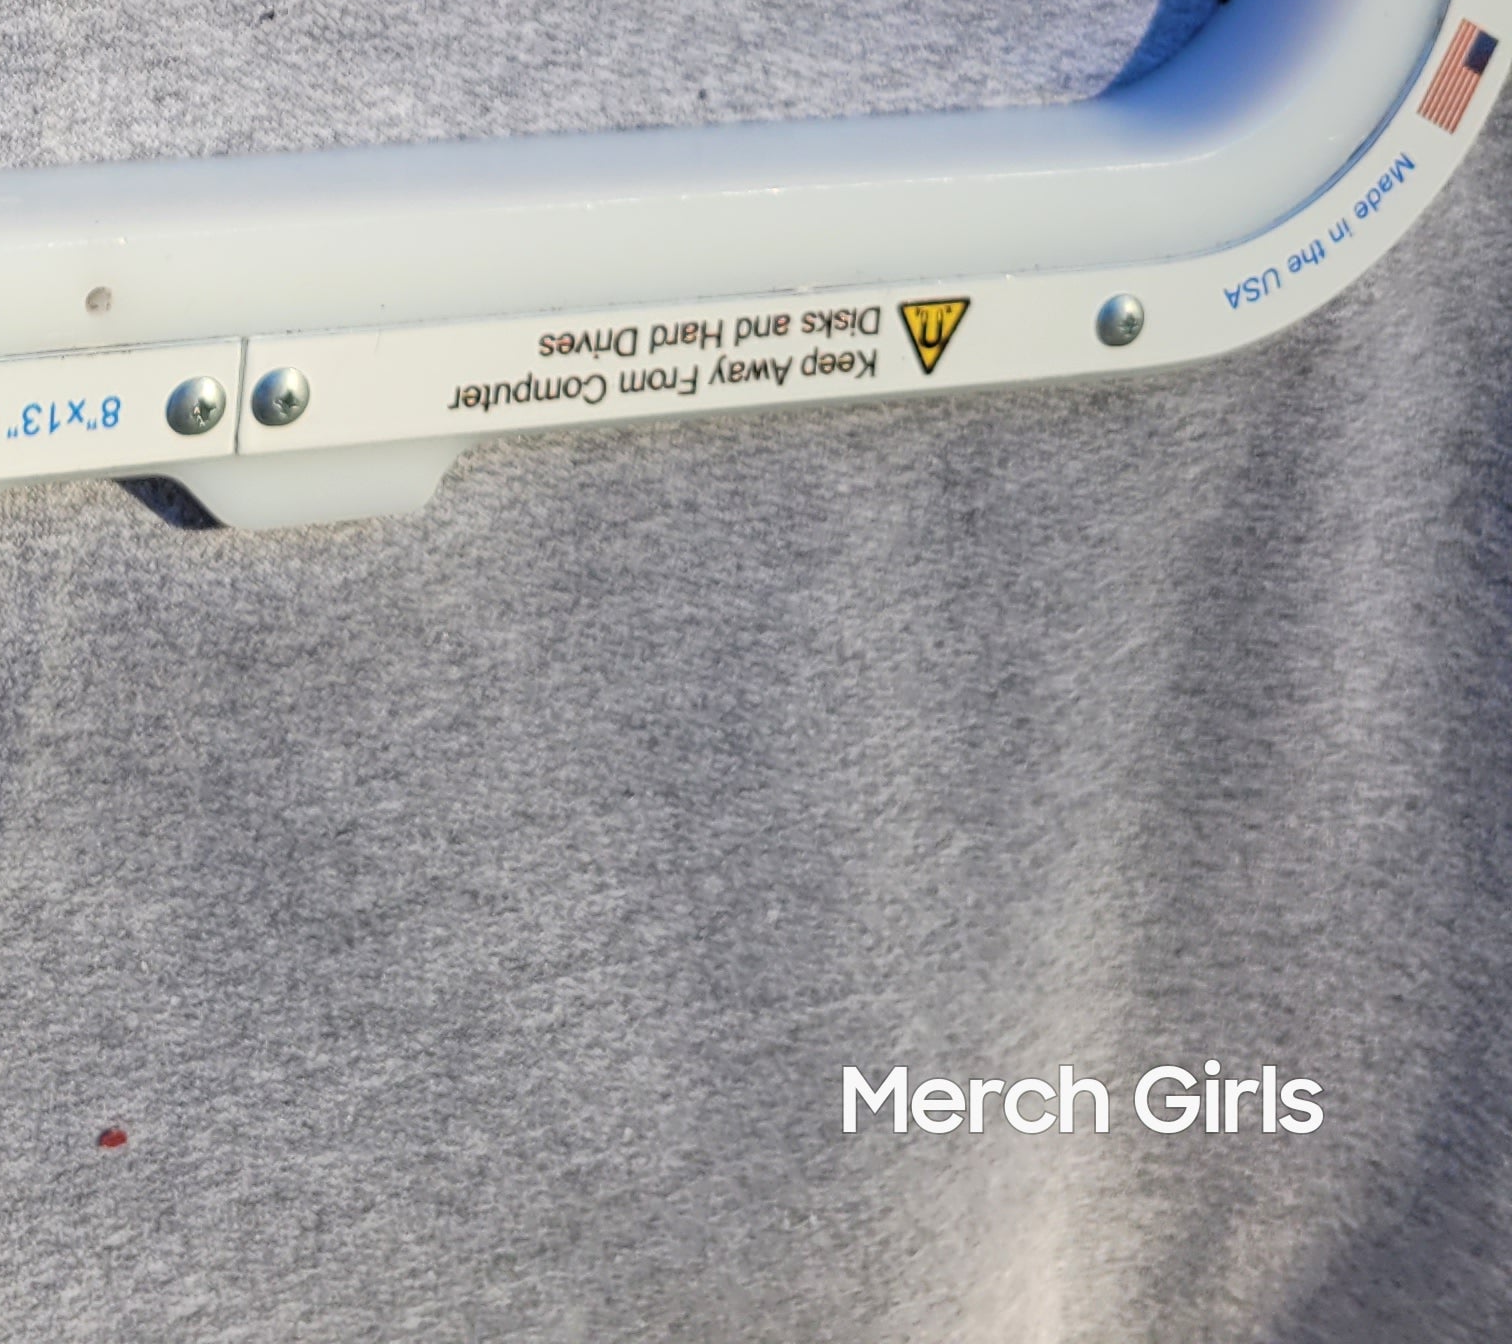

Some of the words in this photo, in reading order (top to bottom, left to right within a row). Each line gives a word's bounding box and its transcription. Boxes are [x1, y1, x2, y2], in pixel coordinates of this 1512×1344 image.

[1353, 152, 1416, 219] Made
[1328, 217, 1353, 243] in
[1287, 239, 1326, 272] the
[1223, 268, 1282, 309] USA
[649, 319, 722, 355] Hard
[734, 313, 792, 348] and
[801, 306, 881, 339] Disks
[539, 325, 638, 359] Drives
[619, 364, 699, 395] From
[709, 353, 793, 386] Away
[801, 347, 878, 379] Keep
[447, 371, 607, 412] Computer
